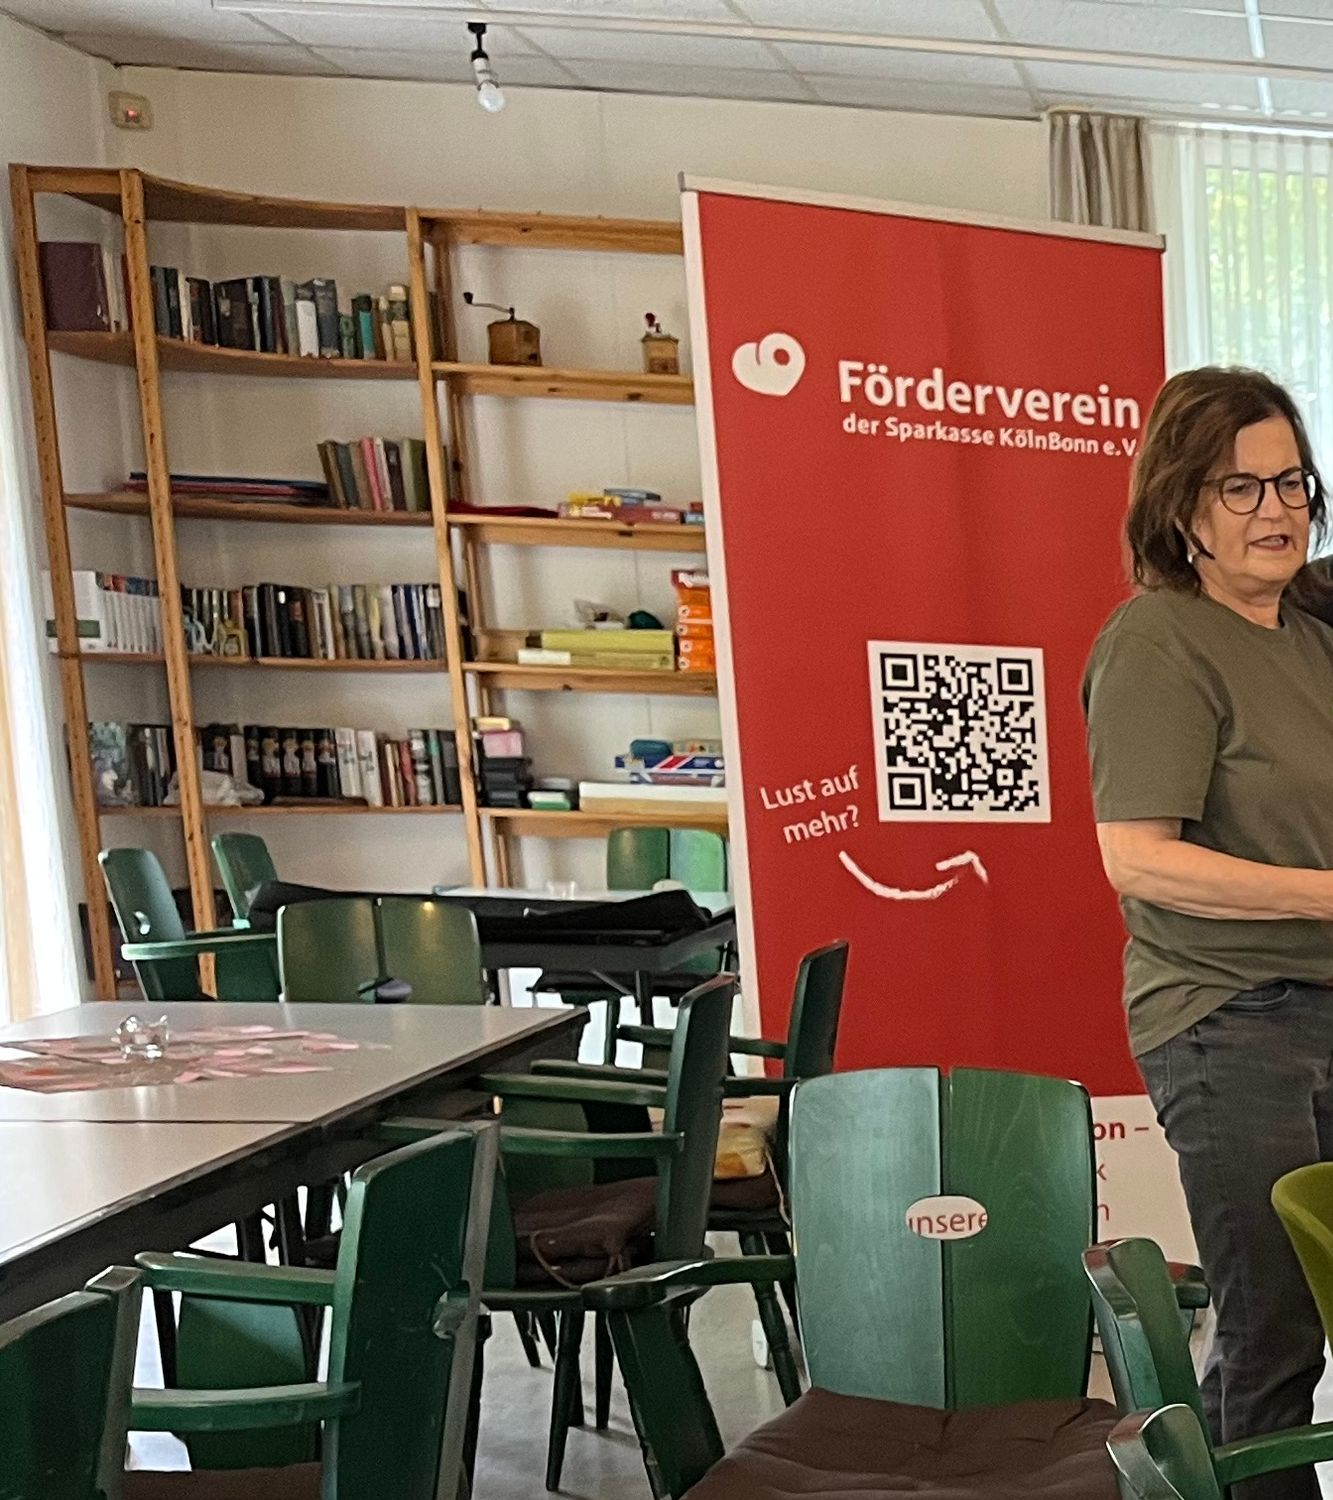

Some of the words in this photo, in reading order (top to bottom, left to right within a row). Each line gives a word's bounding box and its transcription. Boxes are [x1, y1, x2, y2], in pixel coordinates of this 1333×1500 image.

[838, 360, 1140, 429] Förderverein
[842, 413, 879, 438] der
[886, 417, 994, 446] Sparkasse
[999, 429, 1098, 455] KölnBonn
[760, 780, 816, 810] Lust
[821, 765, 859, 797] auf
[783, 805, 859, 844] mehr?
